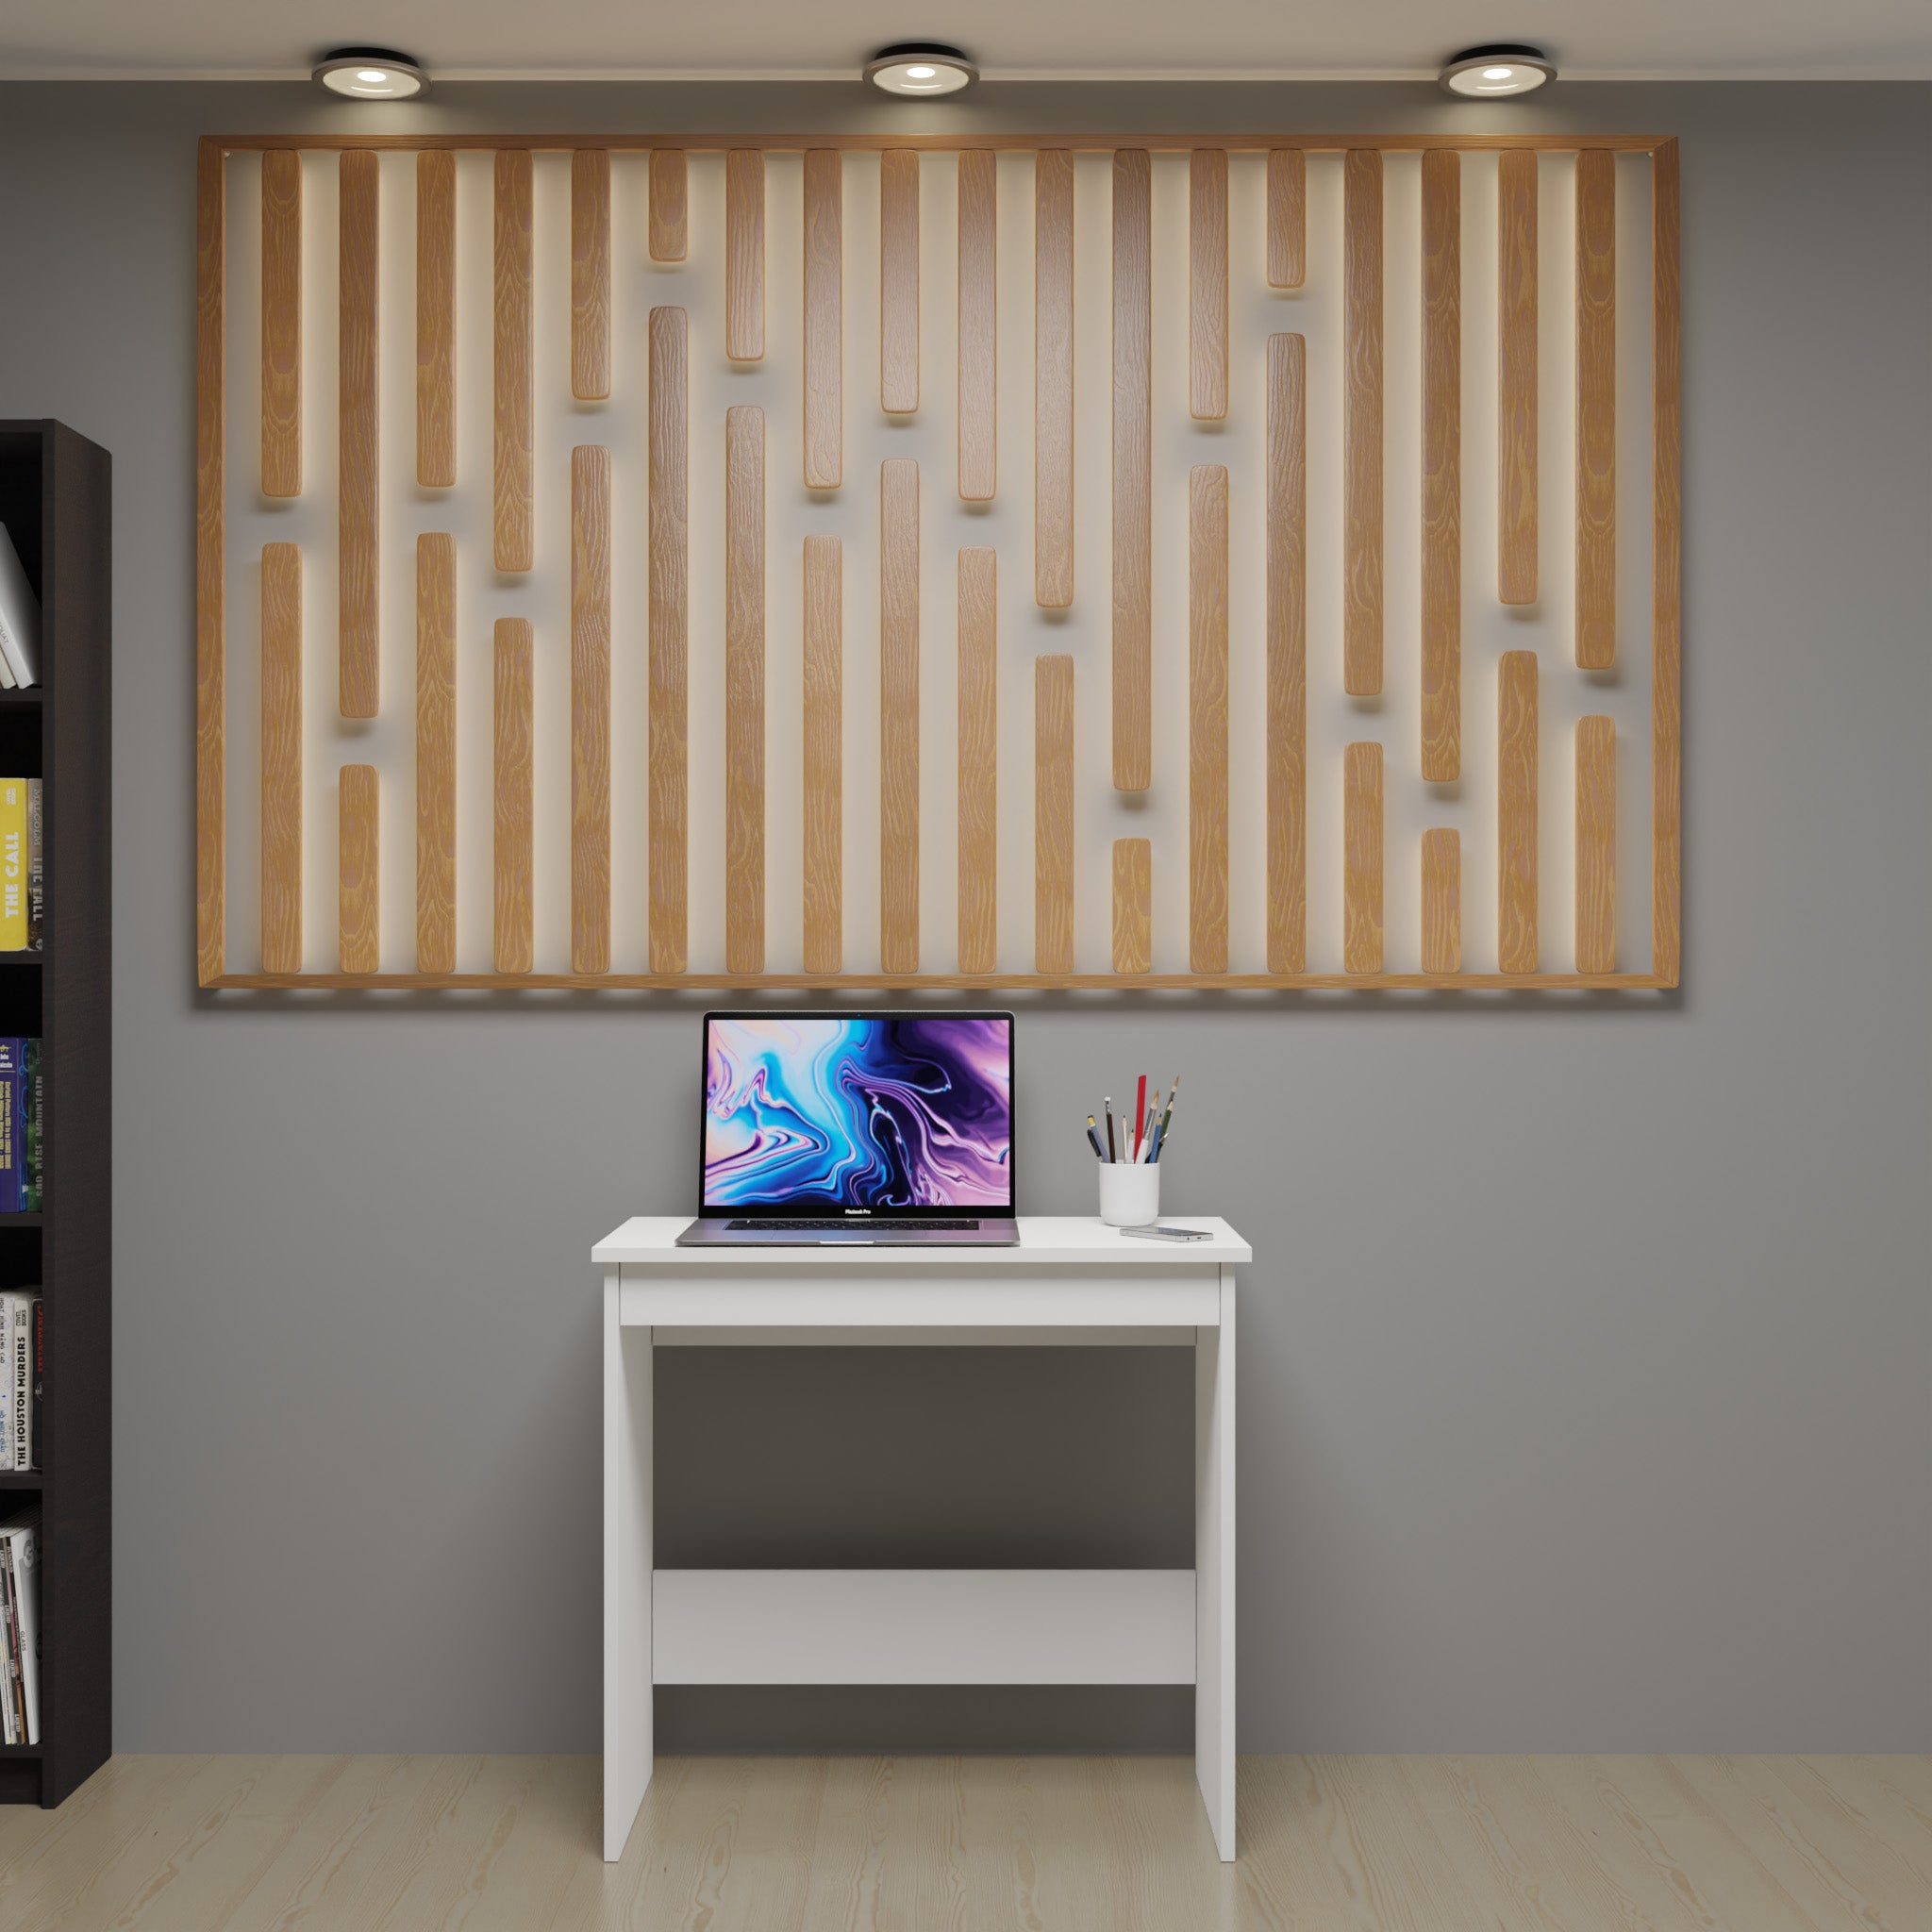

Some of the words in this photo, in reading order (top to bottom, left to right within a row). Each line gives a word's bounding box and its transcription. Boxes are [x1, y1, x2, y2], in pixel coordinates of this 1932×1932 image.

[6, 831, 19, 877] CALL
[6, 884, 19, 919] THE
[35, 1075, 43, 1137] MOUNTAIN
[17, 1336, 26, 1388] MURDERS
[17, 1390, 26, 1444] HOUSTON
[17, 1445, 26, 1466] THE
